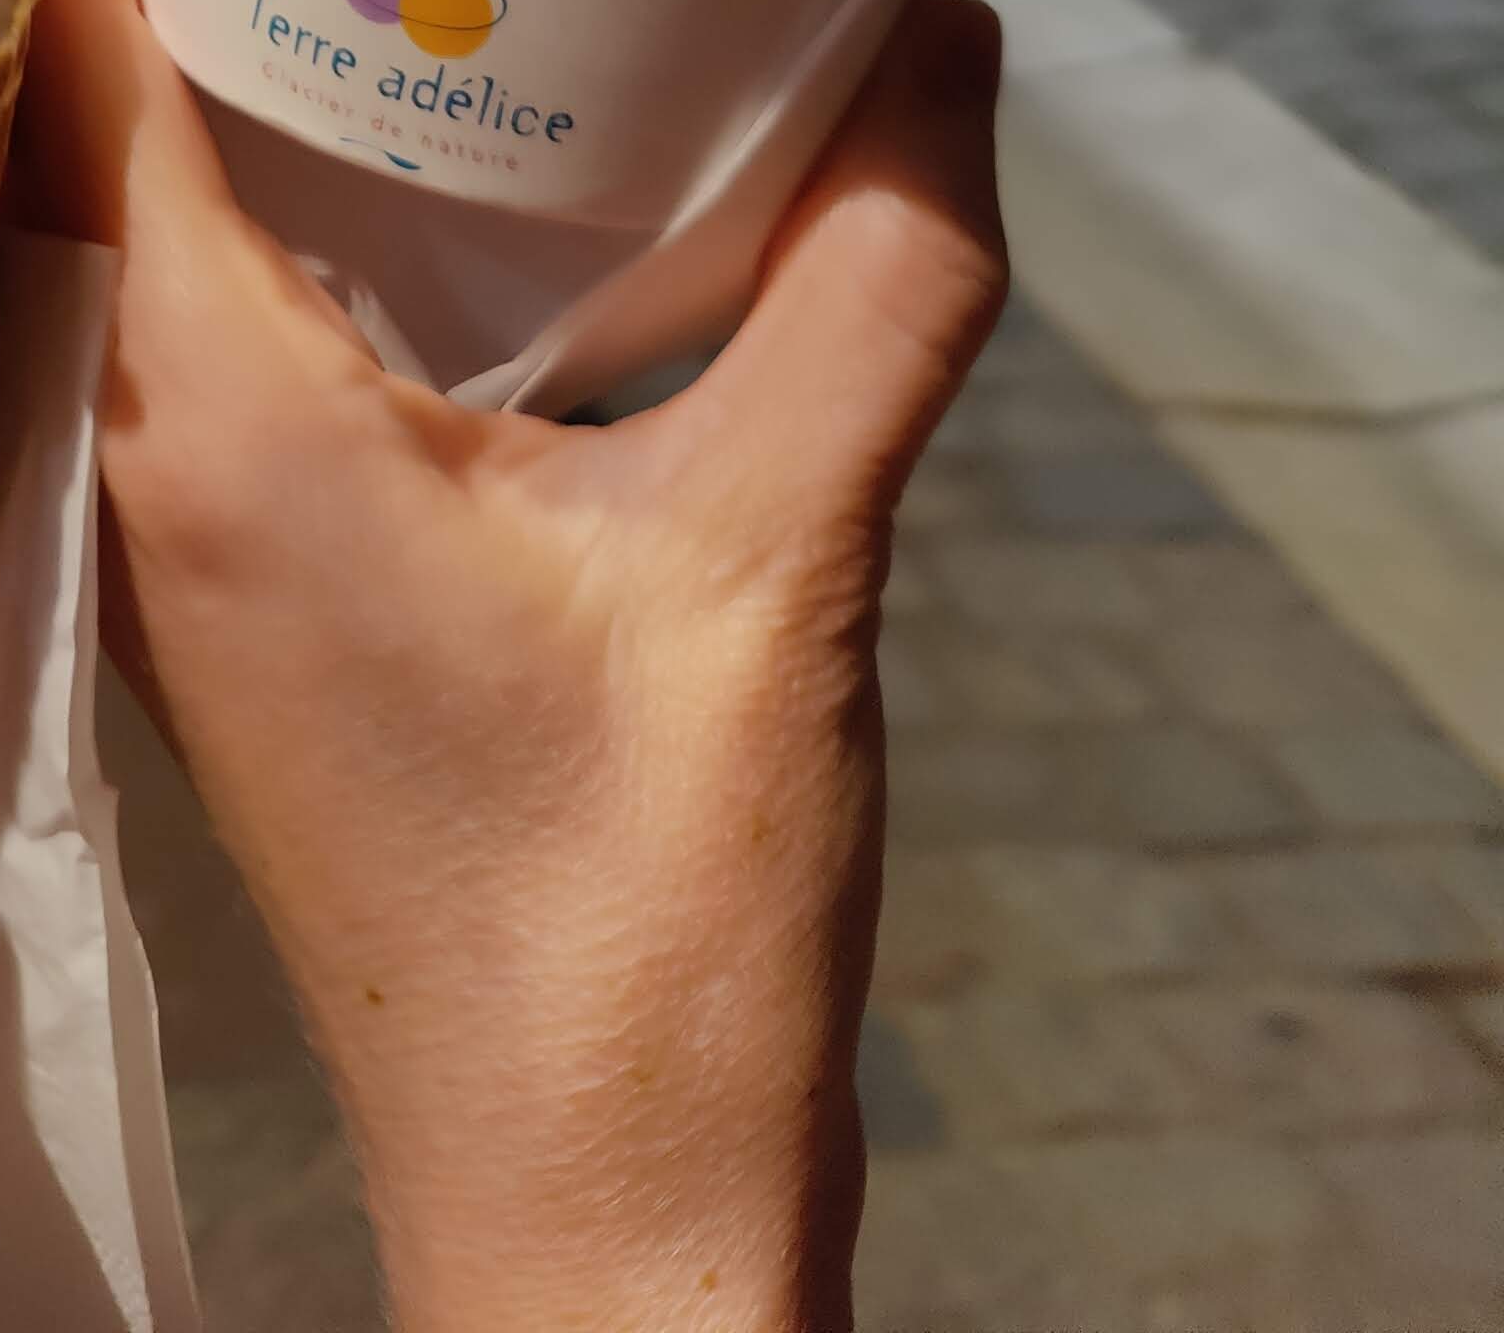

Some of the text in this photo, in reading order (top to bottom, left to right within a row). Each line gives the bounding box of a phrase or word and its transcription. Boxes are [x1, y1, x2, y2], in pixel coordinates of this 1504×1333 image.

[376, 63, 576, 144] adélice
[370, 113, 403, 139] de
[420, 132, 519, 172] nature
